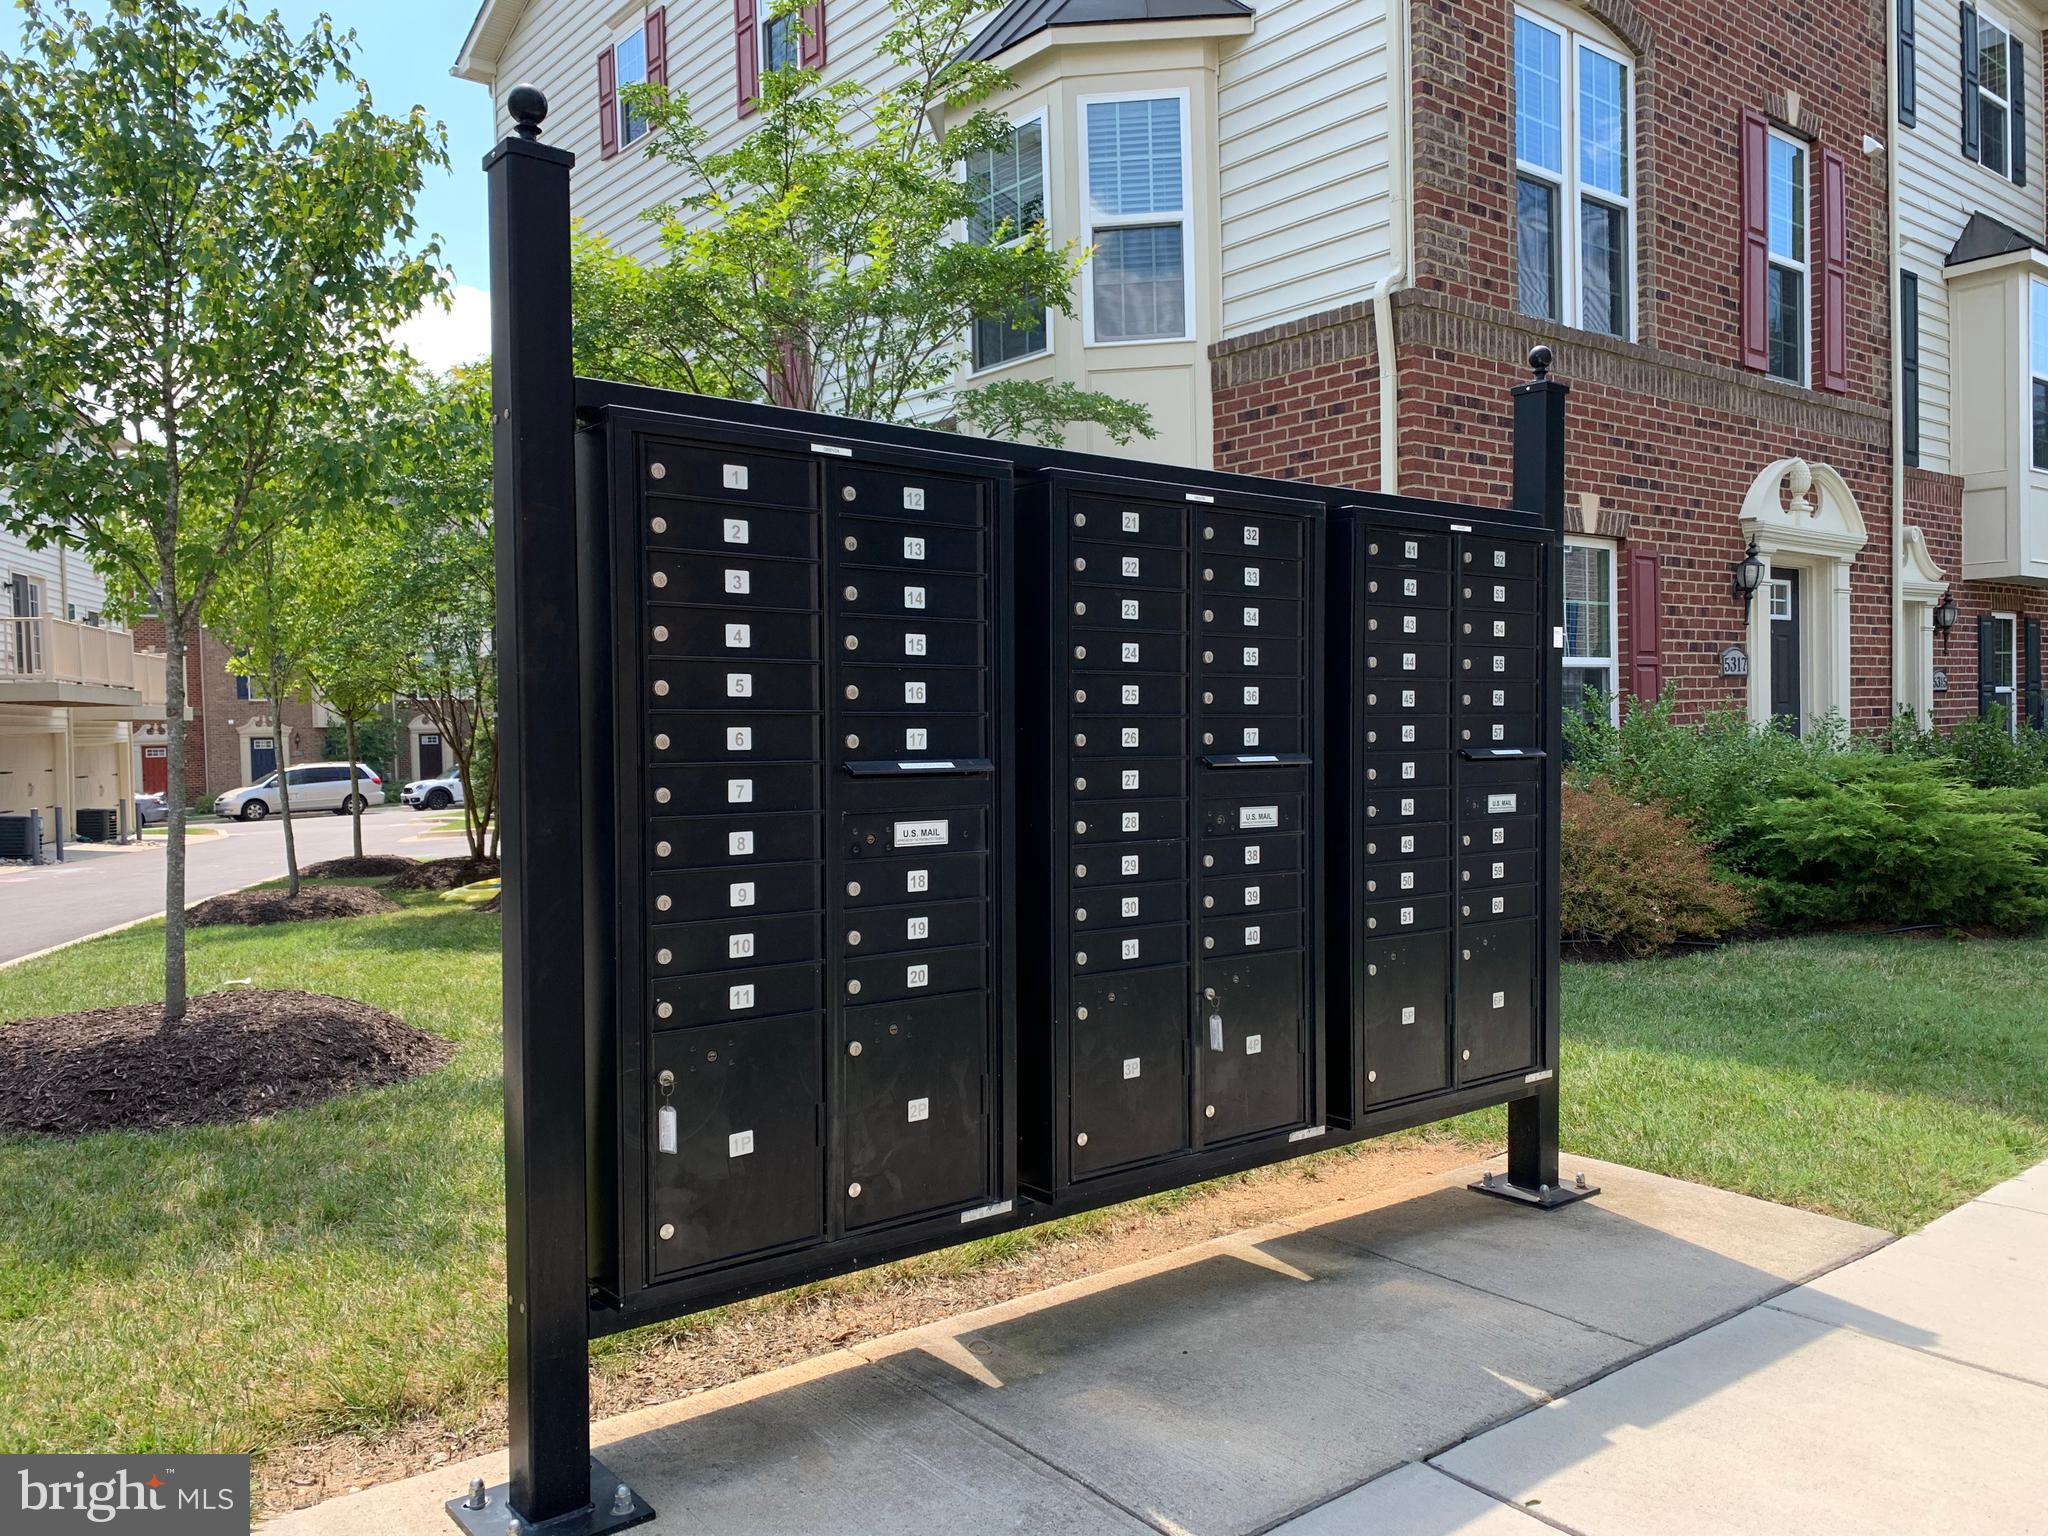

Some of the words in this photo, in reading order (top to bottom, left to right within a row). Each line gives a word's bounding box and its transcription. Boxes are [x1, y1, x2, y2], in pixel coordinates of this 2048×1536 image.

[732, 470, 739, 486] 1
[906, 492, 922, 507] 12
[1124, 516, 1136, 529] 21
[731, 524, 741, 540] 2
[1246, 529, 1257, 541] 32
[907, 541, 922, 557] 13
[1406, 545, 1416, 556] 41
[1496, 554, 1504, 565] 52
[1124, 561, 1137, 574] 22
[733, 575, 742, 590] 3
[1246, 571, 1258, 584] 33
[1405, 582, 1415, 594] 42
[1495, 589, 1504, 600] 53
[907, 591, 923, 605] 14
[1124, 603, 1137, 617] 23
[1246, 611, 1257, 623] 34
[1405, 619, 1415, 631] 43
[1495, 624, 1504, 634] 54
[733, 629, 743, 644] 4
[908, 638, 924, 652] 15
[1124, 647, 1137, 659] 24
[1245, 651, 1257, 663] 35
[1404, 657, 1414, 668] 44
[1494, 659, 1503, 670] 55
[1724, 656, 1748, 672] 5317
[735, 678, 744, 693] 5
[908, 686, 924, 700] 16
[1124, 689, 1137, 702] 25
[1246, 690, 1257, 702] 36
[1404, 694, 1414, 705] 45
[1494, 693, 1503, 704] 56
[1124, 732, 1137, 744] 26
[1246, 731, 1257, 744] 37
[1403, 728, 1413, 740] 46
[1494, 727, 1503, 738] 57
[735, 732, 744, 747] 6
[909, 732, 925, 747] 17
[1403, 765, 1414, 776] 47
[1124, 774, 1137, 787] 27
[735, 784, 745, 799] 7
[1403, 802, 1412, 813] 48
[1124, 816, 1137, 829] 28
[902, 829, 918, 838] U.S.
[920, 828, 940, 837] MAIL
[1494, 831, 1503, 842] 58
[736, 836, 746, 851] 8
[1402, 839, 1412, 850] 49
[1247, 849, 1258, 862] 38
[1124, 859, 1137, 872] 29
[1494, 865, 1503, 876] 59
[910, 874, 926, 889] 18
[1402, 875, 1412, 887] 50
[737, 888, 747, 903] 9
[1247, 890, 1258, 903] 39
[1124, 901, 1137, 914] 30
[1493, 900, 1502, 911] 60
[1402, 910, 1411, 922] 51
[910, 921, 926, 936] 19
[1247, 930, 1258, 942] 40
[732, 938, 751, 954] 10
[1124, 943, 1136, 957] 31
[910, 969, 926, 984] 20
[734, 990, 750, 1005] 11
[1247, 1038, 1260, 1051] 4P
[1125, 1062, 1138, 1076] 3P
[910, 1103, 926, 1118] 2P
